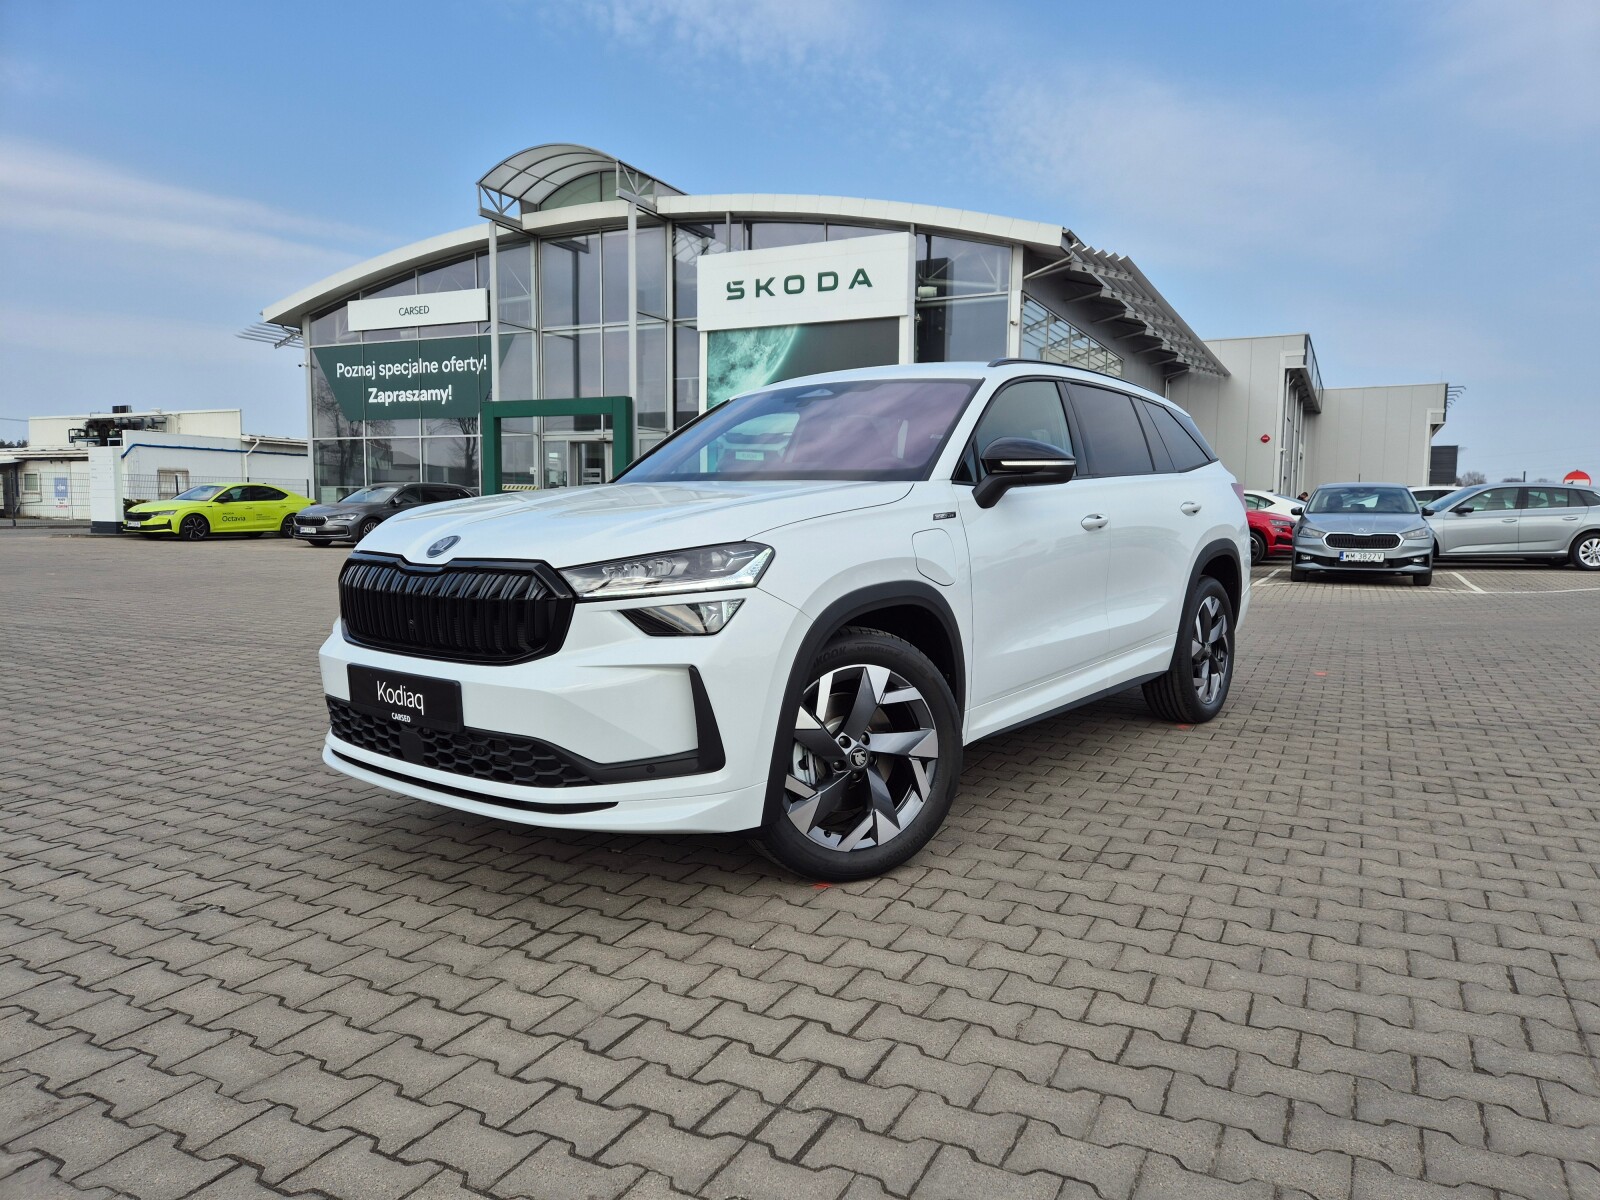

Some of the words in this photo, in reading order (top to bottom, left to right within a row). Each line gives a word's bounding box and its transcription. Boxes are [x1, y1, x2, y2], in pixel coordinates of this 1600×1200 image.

[398, 305, 430, 316] CARSED
[336, 361, 376, 380] Poznaj
[378, 357, 439, 379] specjalne
[441, 354, 487, 375] oferty!
[367, 384, 453, 407] Zapraszamy!
[376, 680, 425, 716] Kodiaq
[391, 712, 411, 722] CARSED
